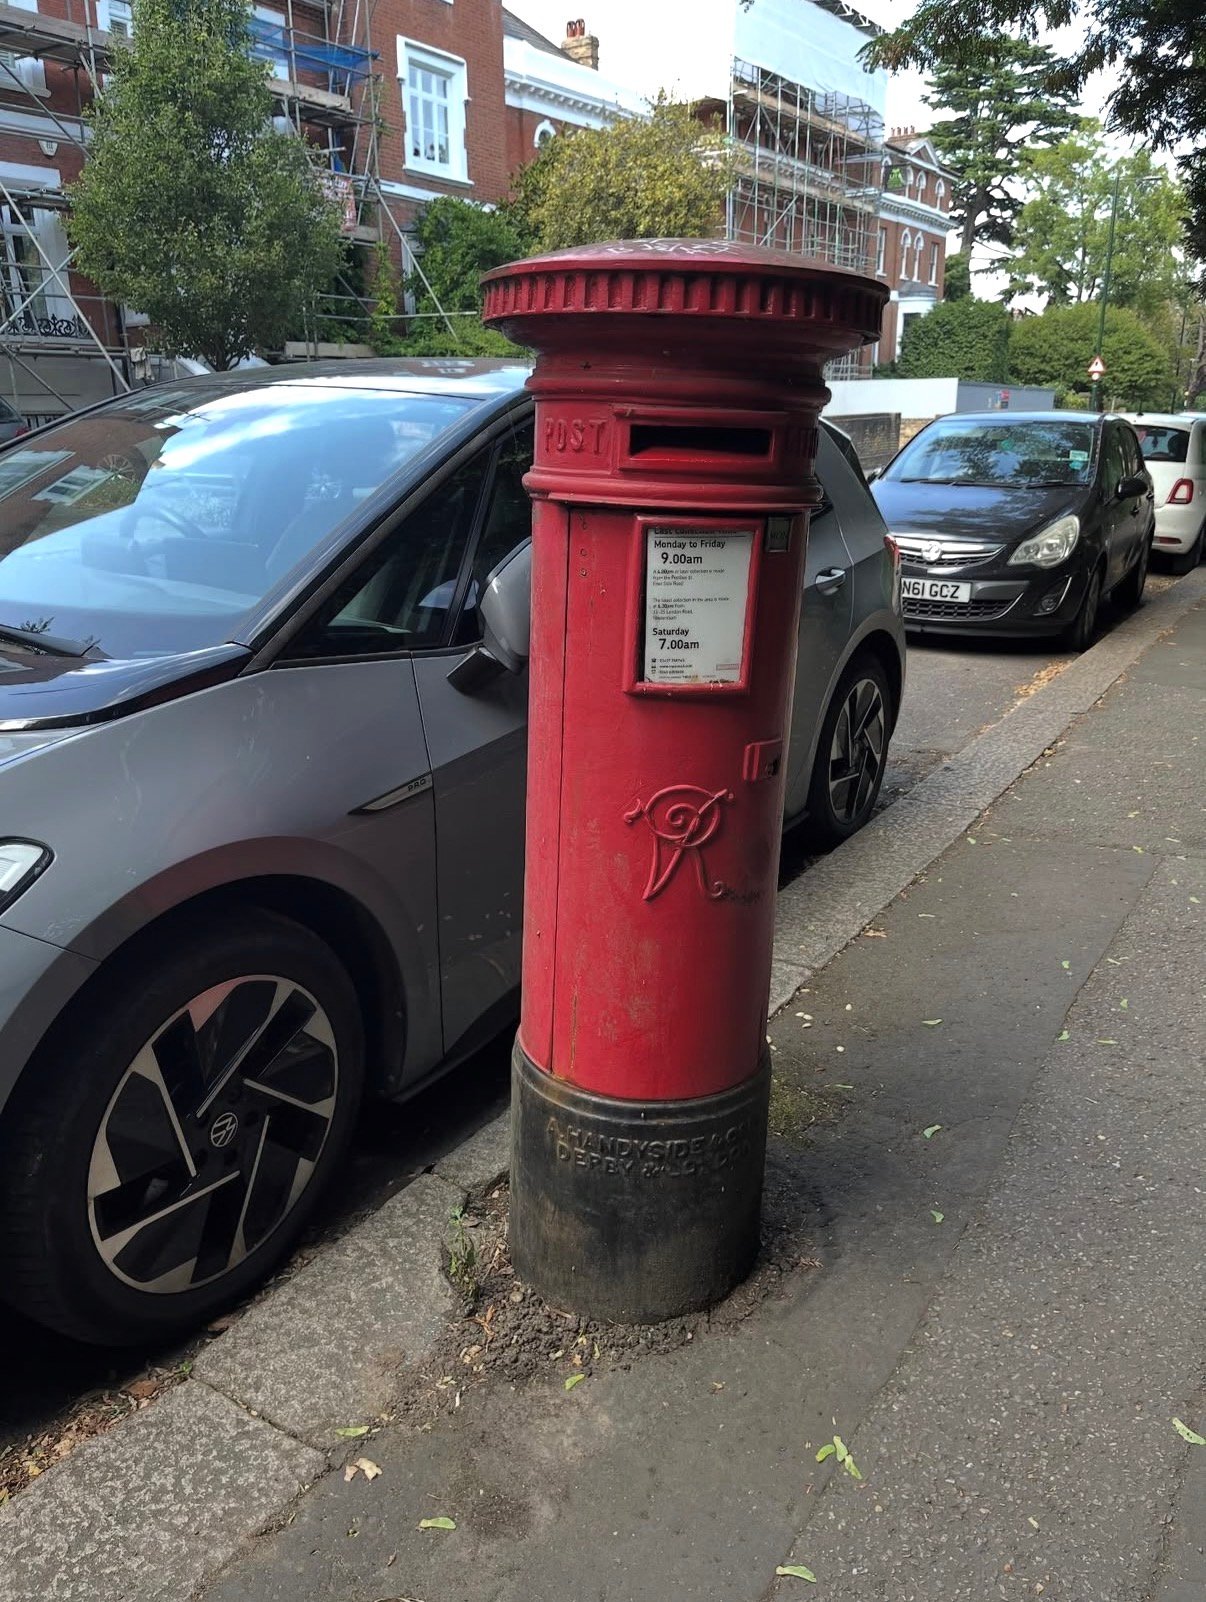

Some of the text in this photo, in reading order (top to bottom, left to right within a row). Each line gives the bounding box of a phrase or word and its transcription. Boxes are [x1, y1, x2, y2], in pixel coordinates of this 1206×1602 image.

[544, 417, 609, 456] POST
[654, 540, 687, 550] Monday
[700, 540, 726, 549] Friday
[661, 552, 703, 565] 9.00am
[929, 583, 960, 599] GCZ
[652, 628, 690, 636] Saturday
[659, 638, 700, 650] 7.00am
[407, 778, 427, 792] PRO
